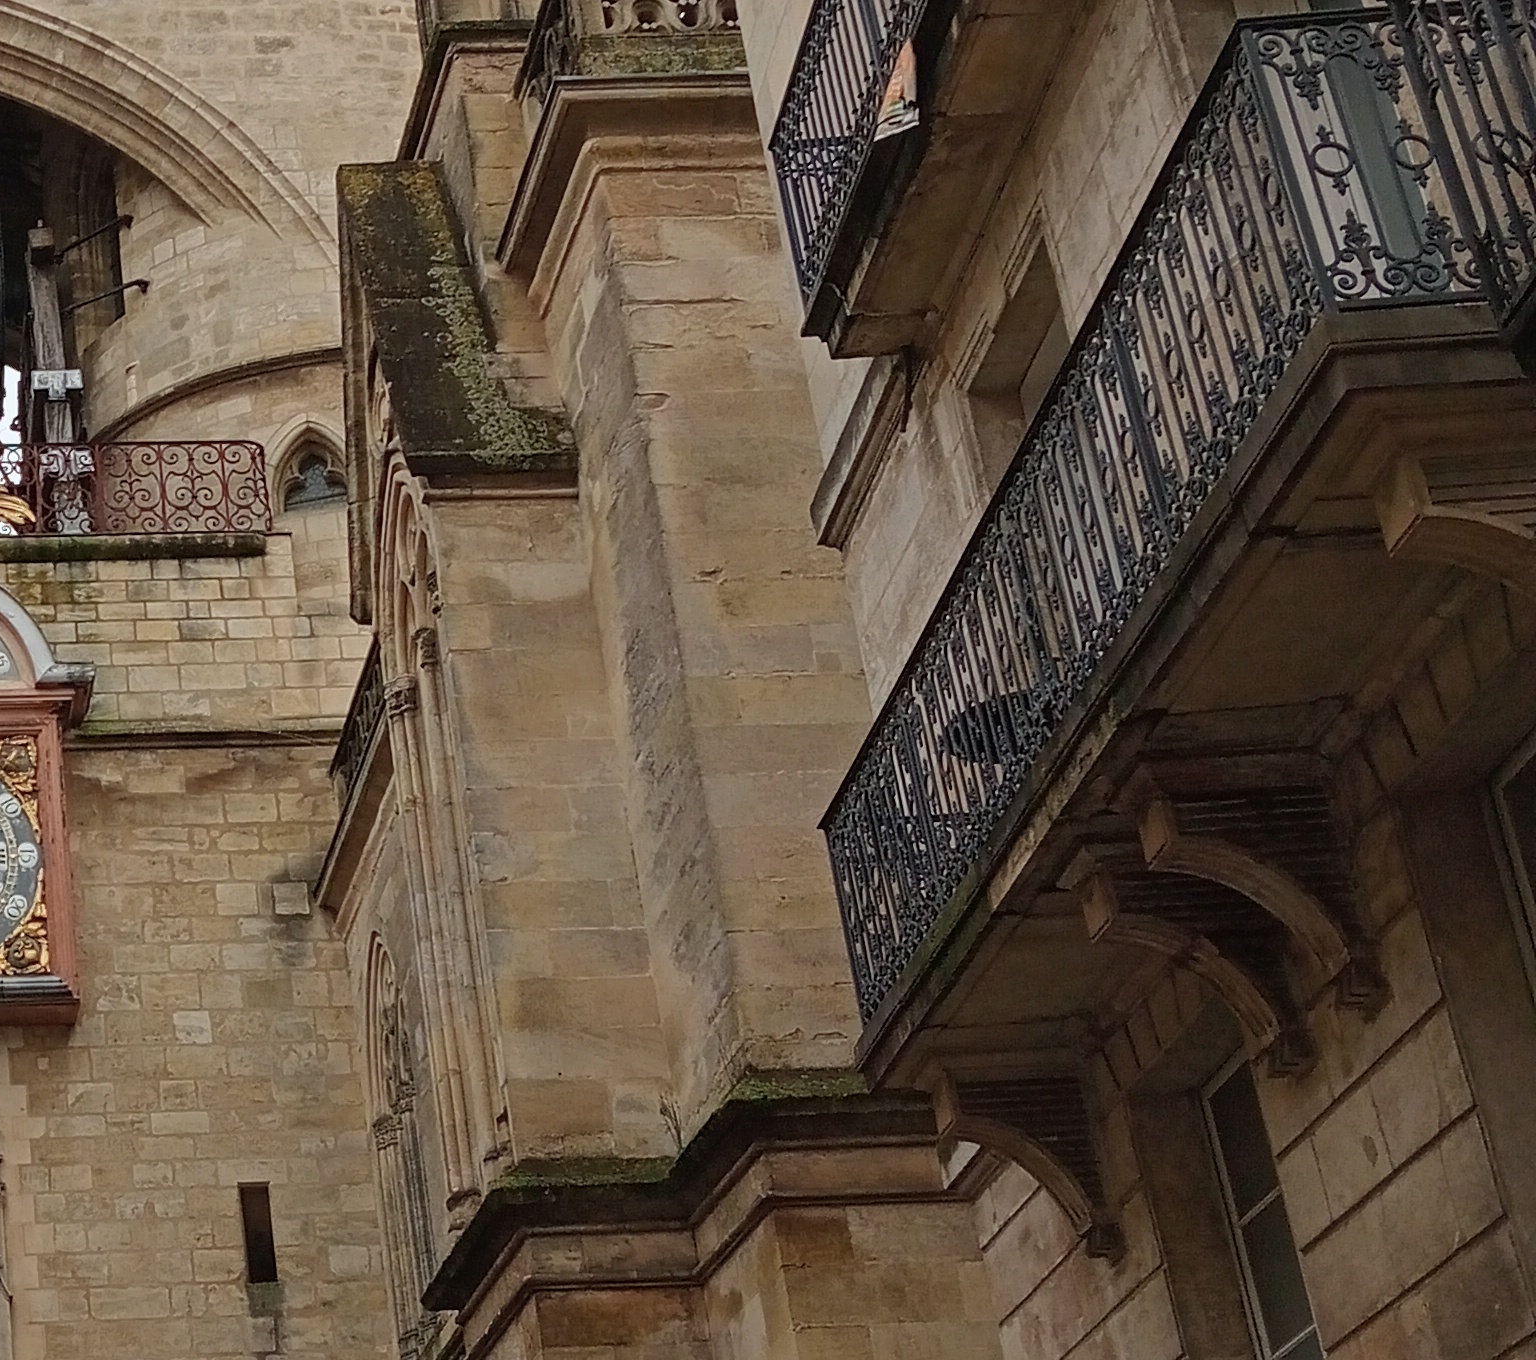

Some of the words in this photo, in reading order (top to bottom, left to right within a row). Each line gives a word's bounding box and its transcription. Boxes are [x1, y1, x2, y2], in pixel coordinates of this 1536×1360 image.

[2, 796, 20, 814] 10
[19, 848, 35, 866] 15
[7, 899, 26, 919] 20
